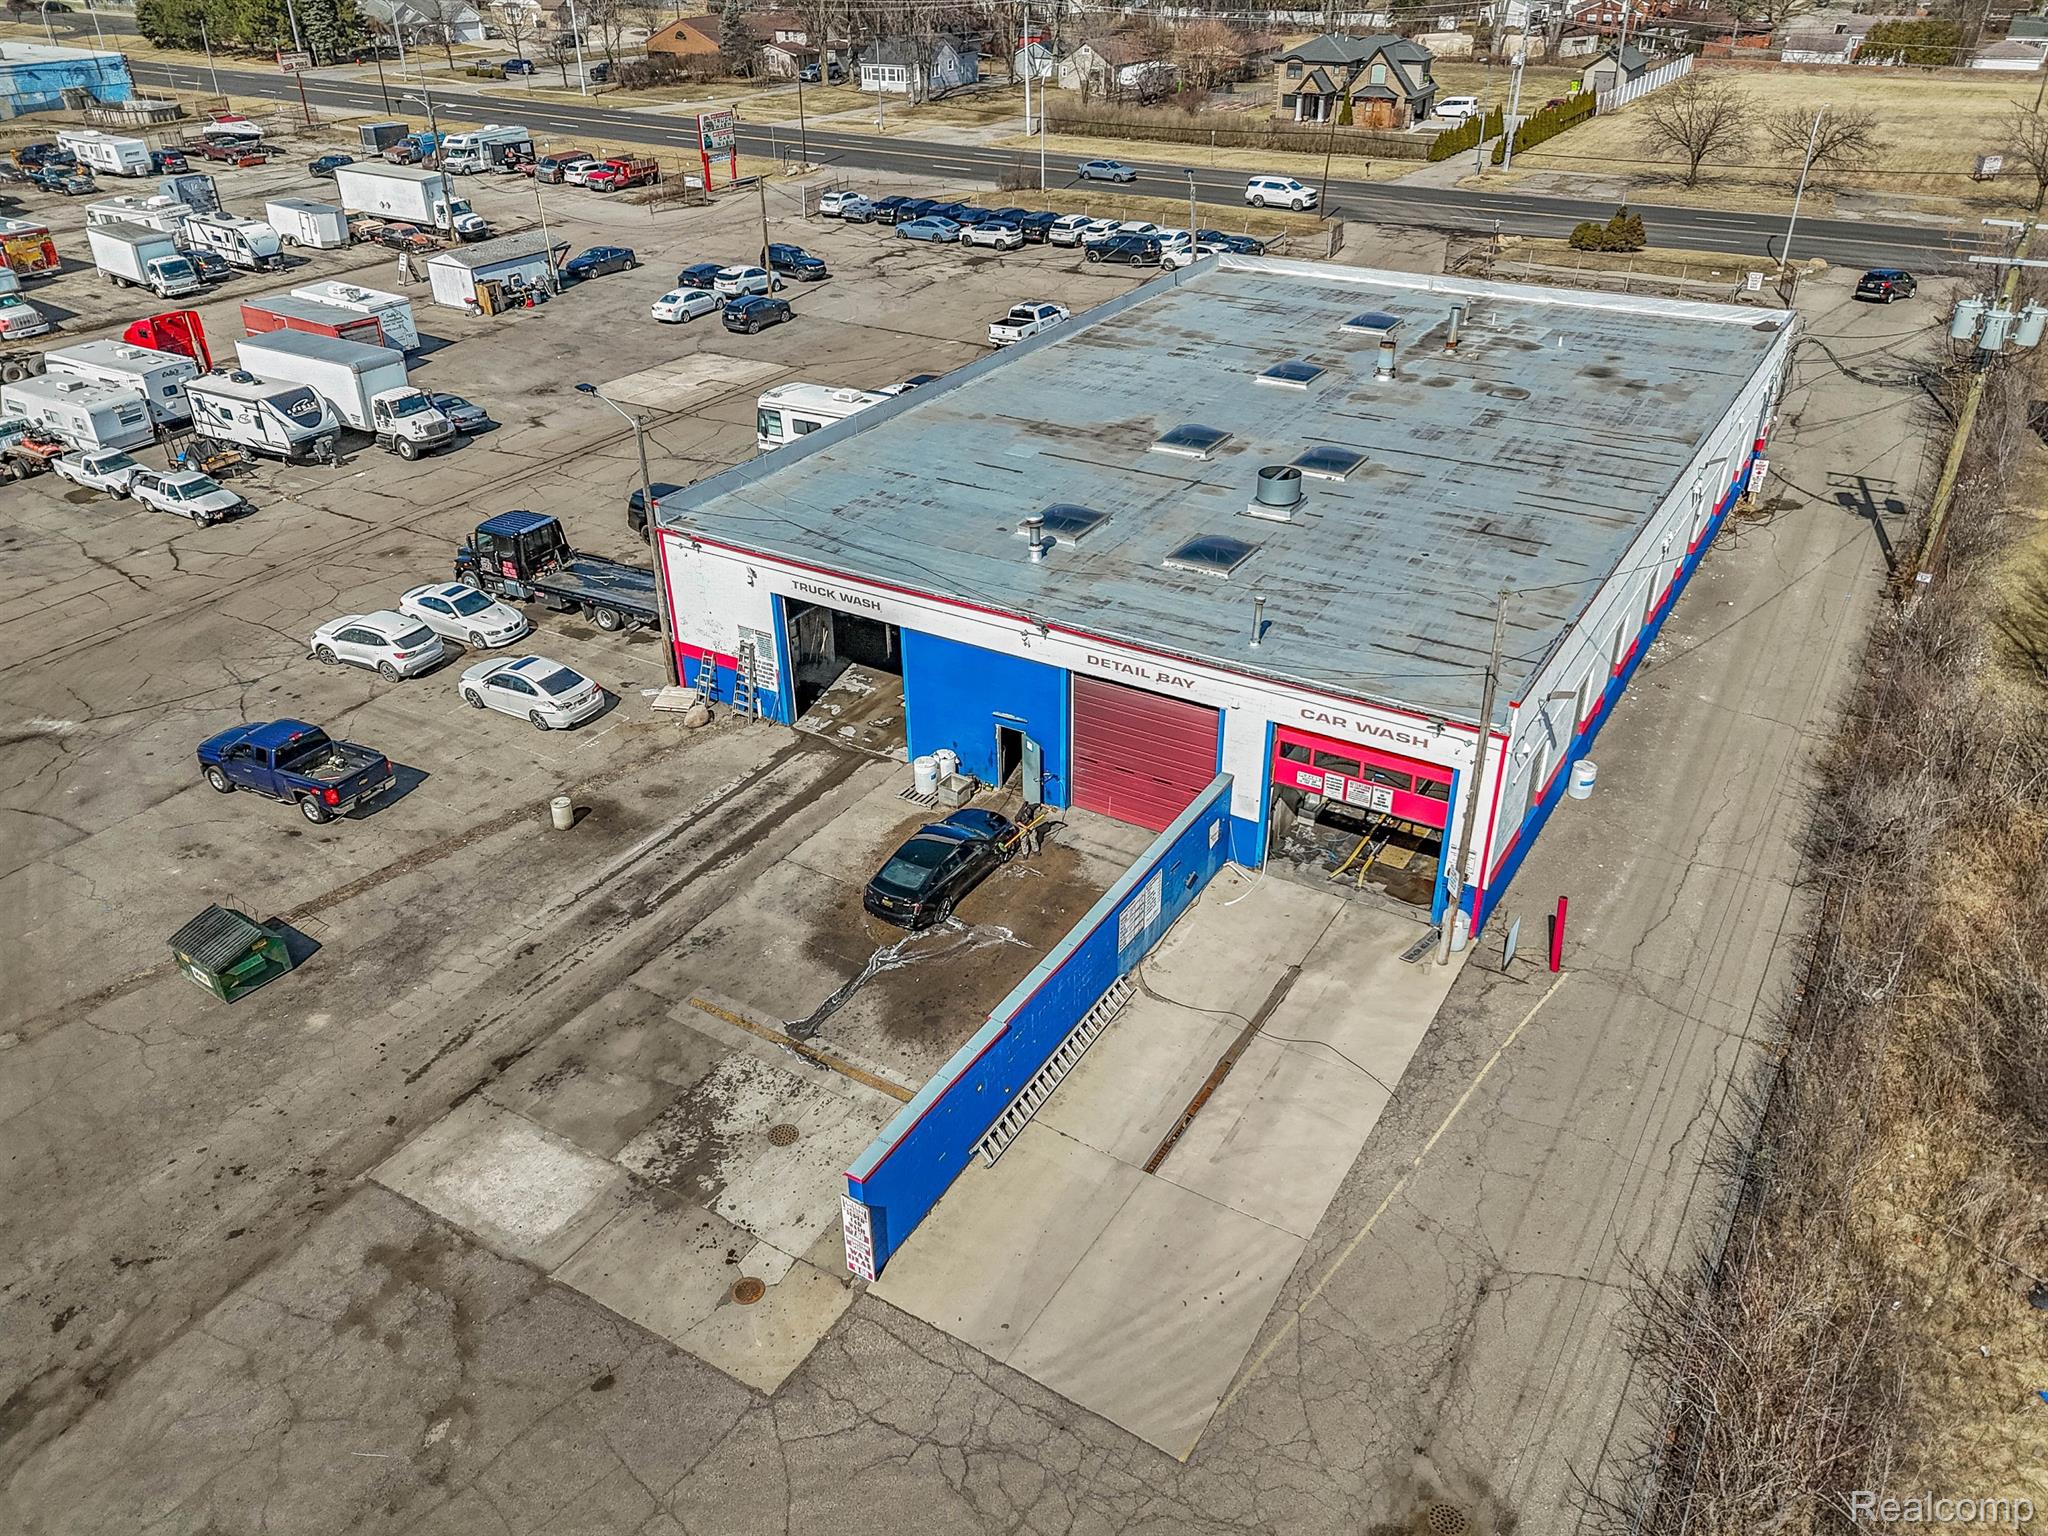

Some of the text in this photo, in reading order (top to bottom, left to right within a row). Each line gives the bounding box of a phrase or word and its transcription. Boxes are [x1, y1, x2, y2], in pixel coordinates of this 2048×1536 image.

[791, 580, 881, 611] TRUCK WASH
[1087, 654, 1196, 689] DETAIL BAY
[1300, 708, 1430, 749] CAR WASH
[849, 1247, 870, 1263] WAX
